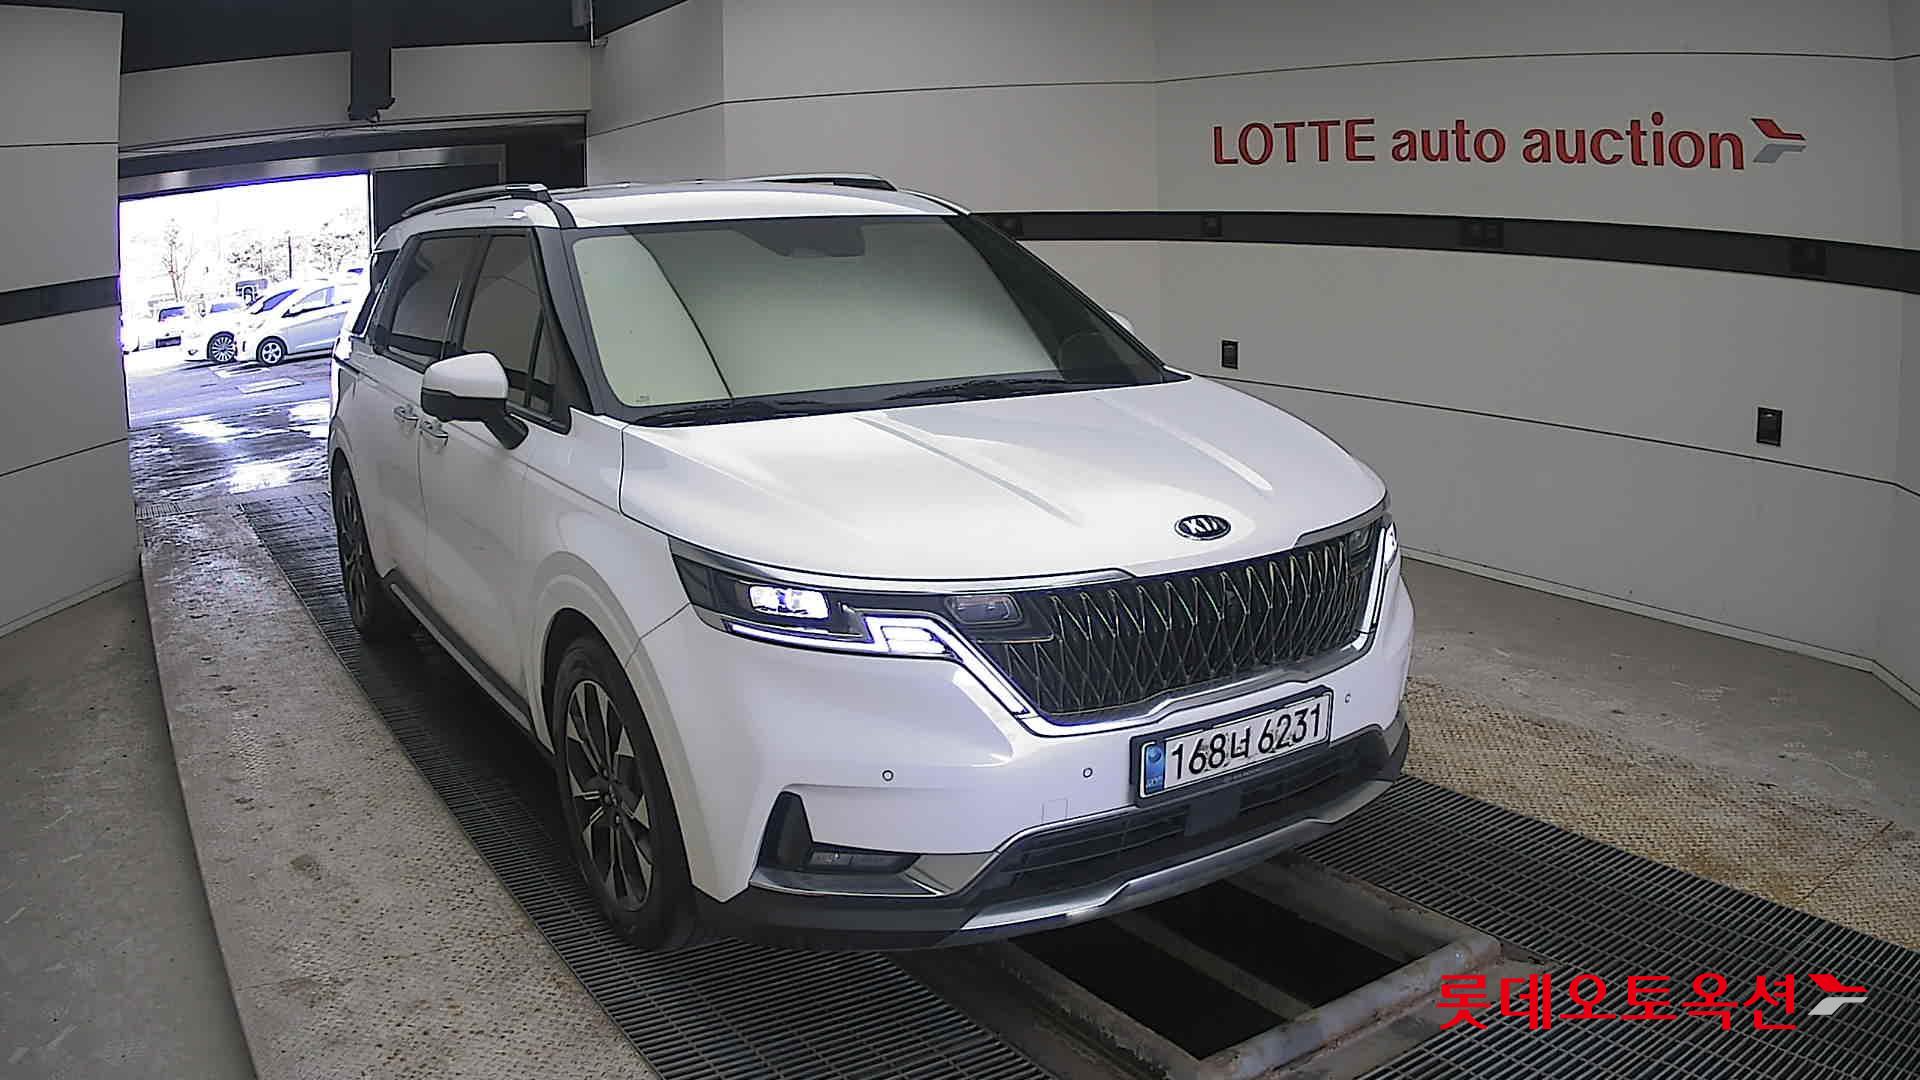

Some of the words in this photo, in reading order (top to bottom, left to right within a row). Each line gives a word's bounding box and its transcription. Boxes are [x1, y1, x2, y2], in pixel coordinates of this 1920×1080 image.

[1213, 118, 1376, 165] LOTTE
[1391, 119, 1506, 163] auto
[1522, 111, 1745, 170] auction
[1182, 517, 1227, 534] KIA
[1171, 726, 1251, 780] 168너
[1257, 702, 1321, 754] 6231
